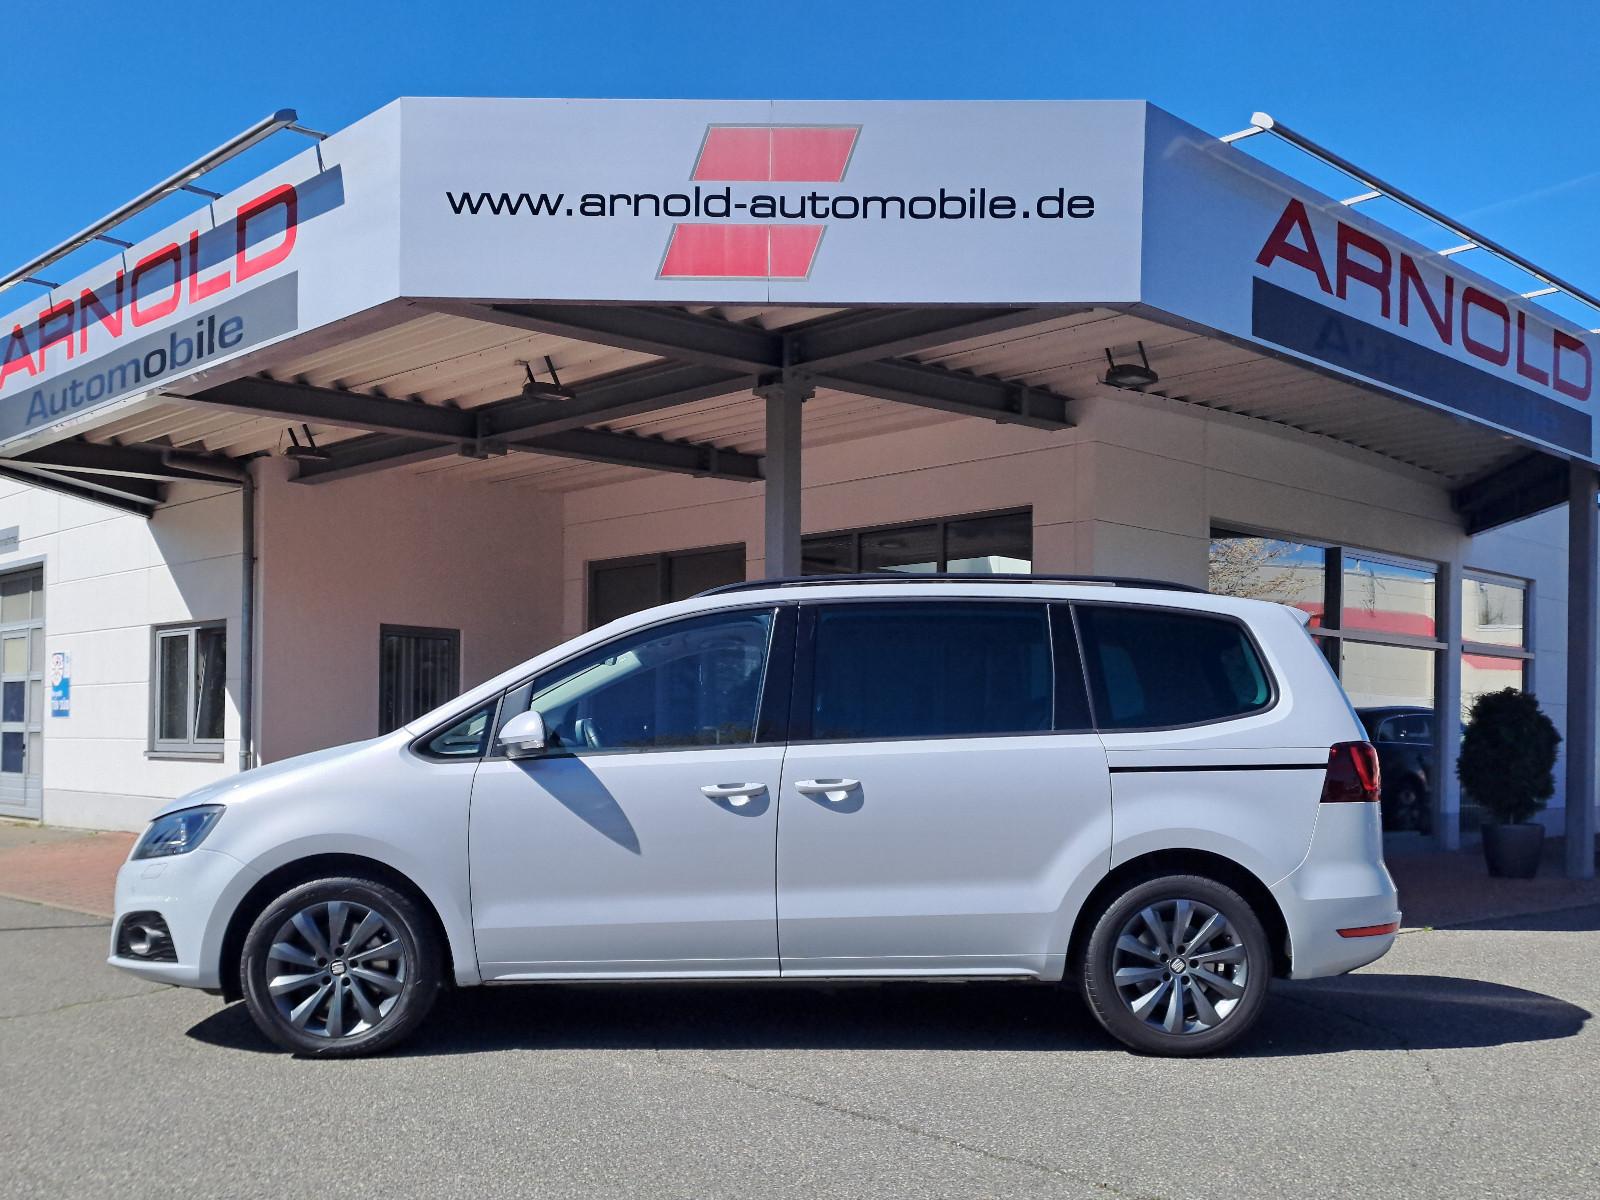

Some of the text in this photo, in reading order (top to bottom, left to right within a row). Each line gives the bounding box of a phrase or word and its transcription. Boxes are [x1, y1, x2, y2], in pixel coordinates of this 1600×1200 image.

[446, 186, 1095, 219] www.arnold-automobile.de
[0, 183, 298, 391] ARNOLD
[1255, 197, 1593, 402] ARNOLD
[25, 314, 244, 426] Automobile
